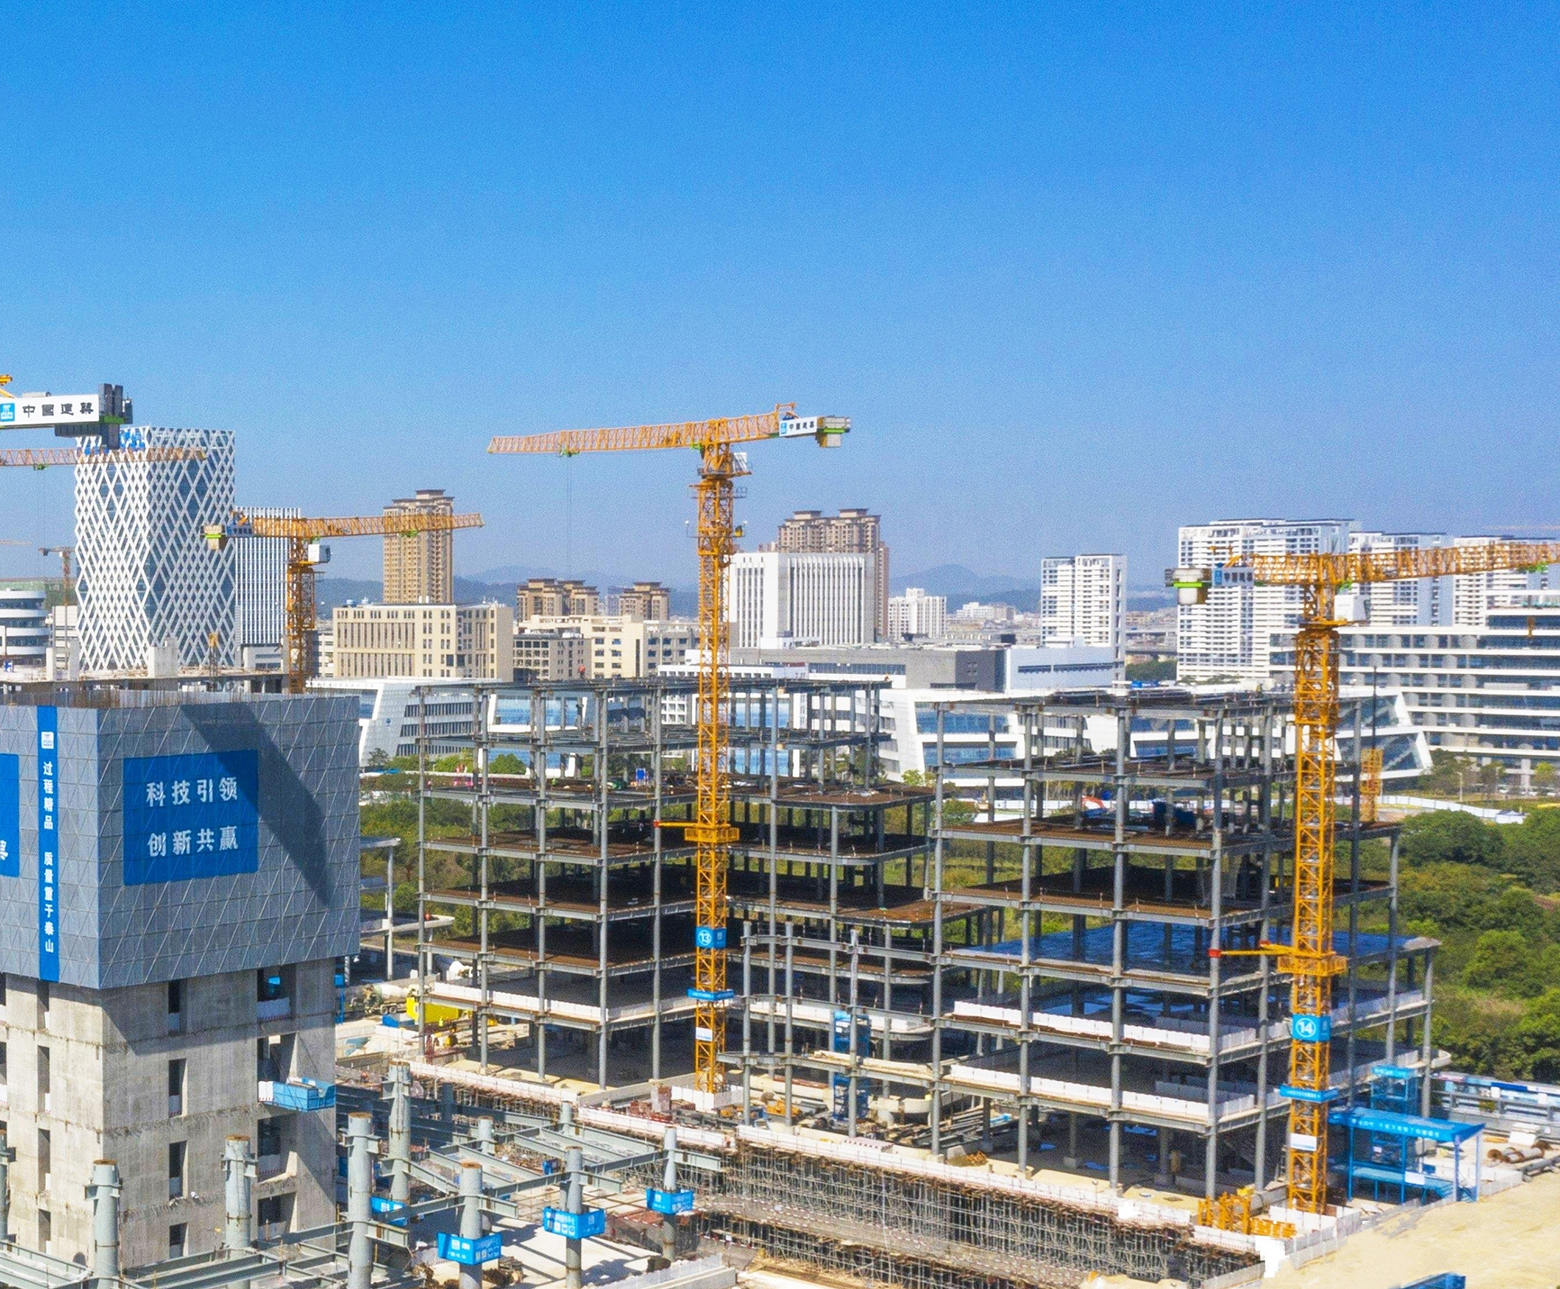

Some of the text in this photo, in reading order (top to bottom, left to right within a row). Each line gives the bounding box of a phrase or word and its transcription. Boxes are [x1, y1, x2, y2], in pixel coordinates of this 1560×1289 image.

[146, 777, 238, 807] 科技引领
[147, 825, 239, 857] 创新共赢
[43, 761, 55, 954] 过程精品 质量重于泰山
[1298, 1020, 1314, 1035] 14
